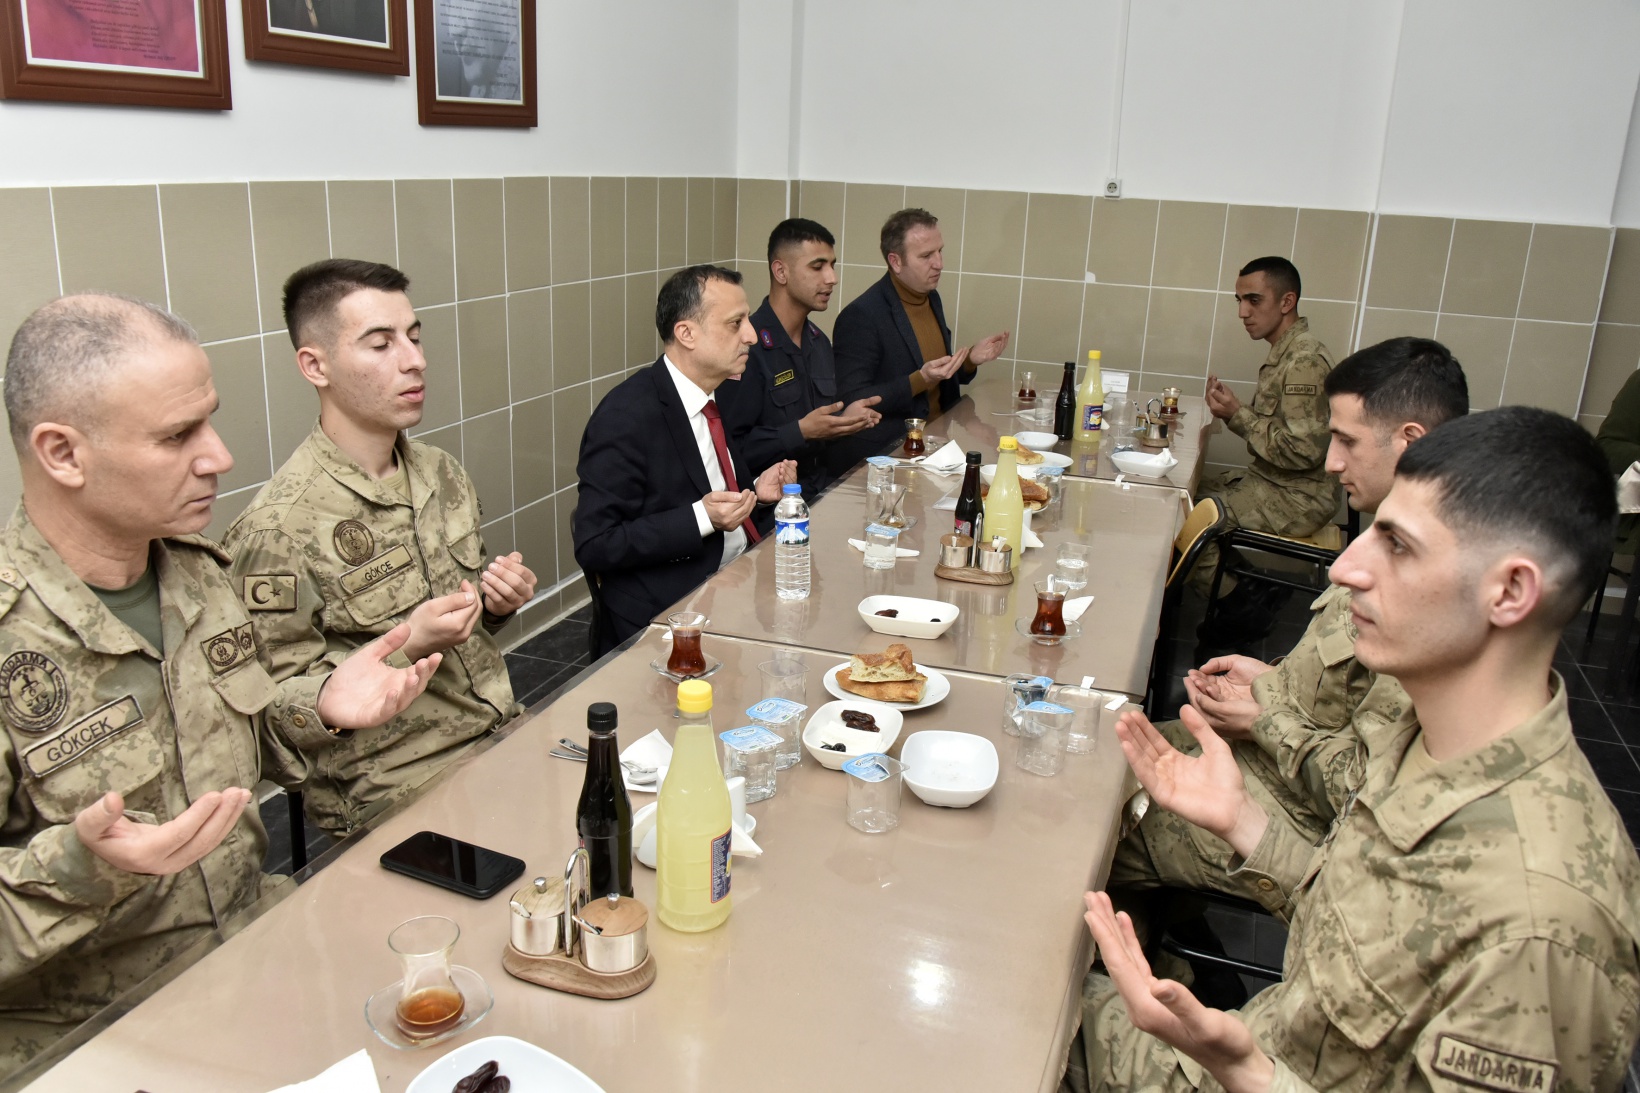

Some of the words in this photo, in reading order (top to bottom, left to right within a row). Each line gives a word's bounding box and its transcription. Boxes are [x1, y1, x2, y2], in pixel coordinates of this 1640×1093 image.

[364, 561, 394, 582] GÖKÇE
[47, 716, 114, 762] GÖKCEK
[1444, 1047, 1544, 1090] JANDARMA
